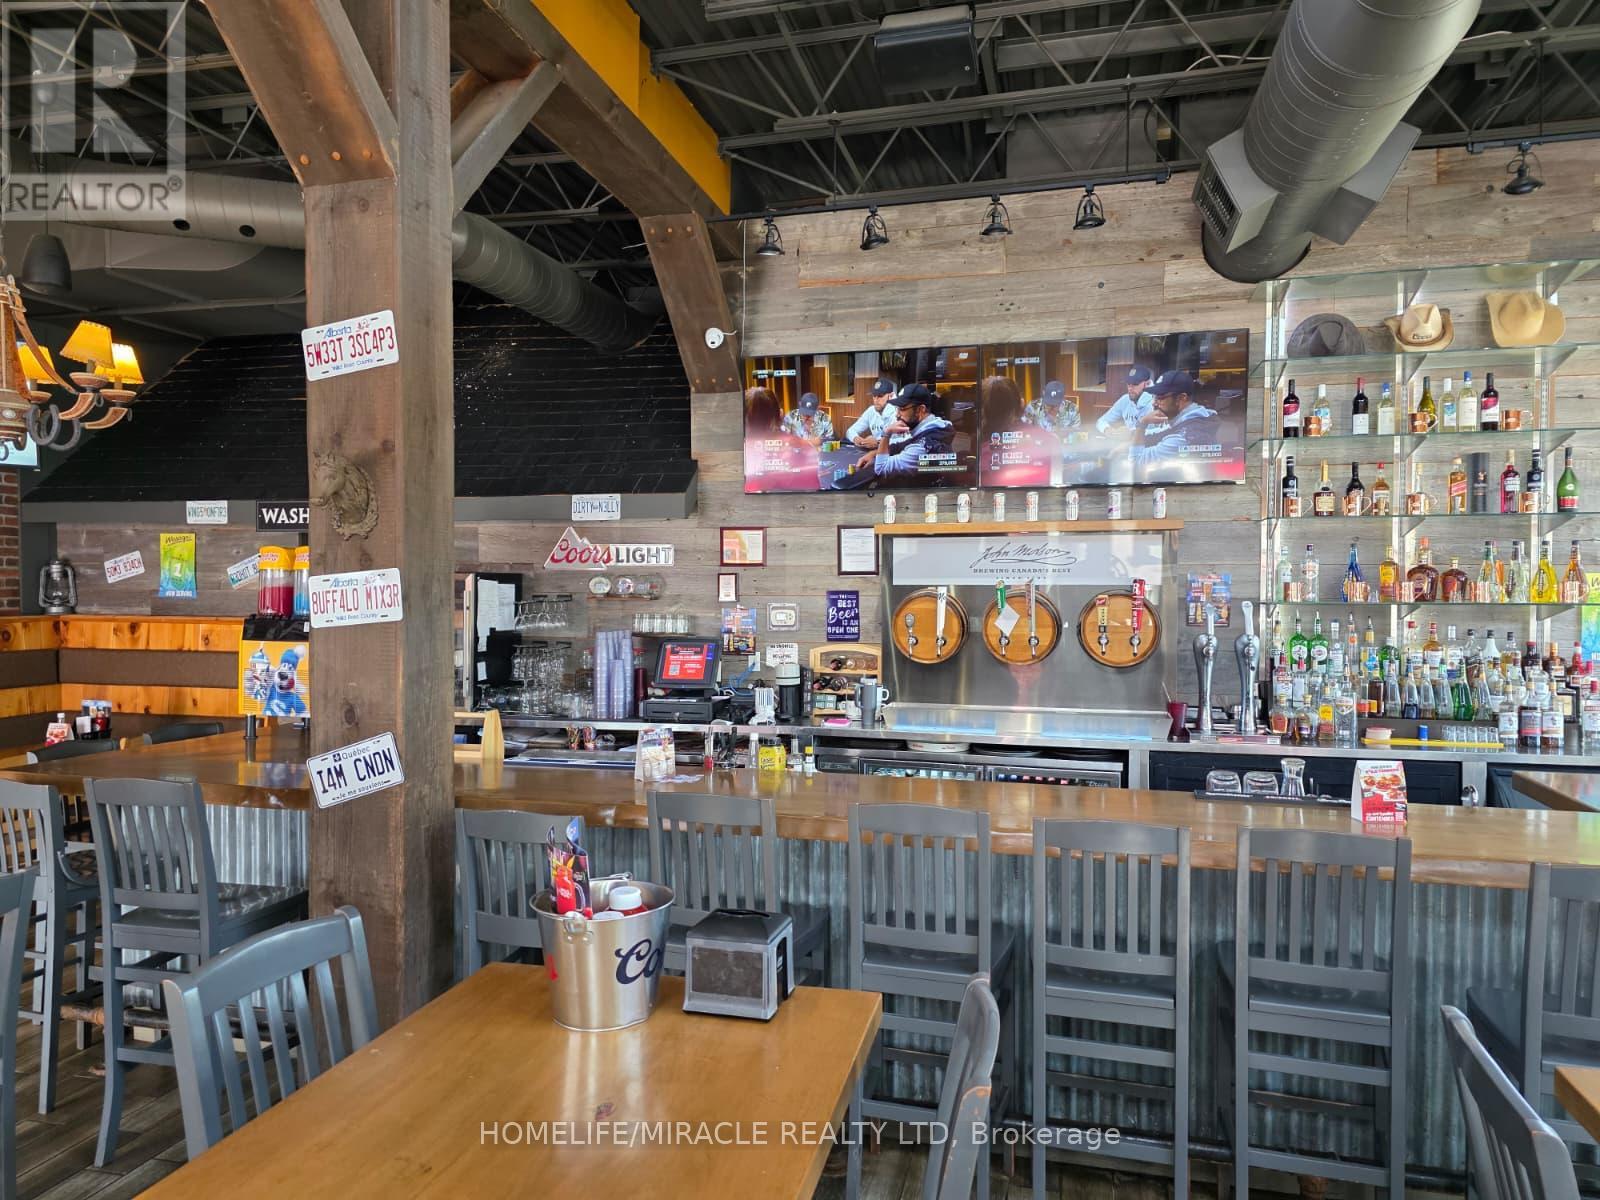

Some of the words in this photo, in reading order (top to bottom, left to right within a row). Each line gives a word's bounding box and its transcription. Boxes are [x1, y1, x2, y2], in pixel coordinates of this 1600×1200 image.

[323, 326, 352, 338] Alberta
[261, 507, 310, 524] WASH
[550, 539, 613, 563] Coors
[615, 547, 673, 563] LIGHT
[330, 577, 359, 588] Alberta
[837, 599, 857, 608] BEST
[828, 606, 859, 623] Beer
[828, 626, 845, 634] OPEN
[846, 626, 859, 634] ONE
[341, 745, 371, 760] Québec
[353, 747, 396, 782] CNDN
